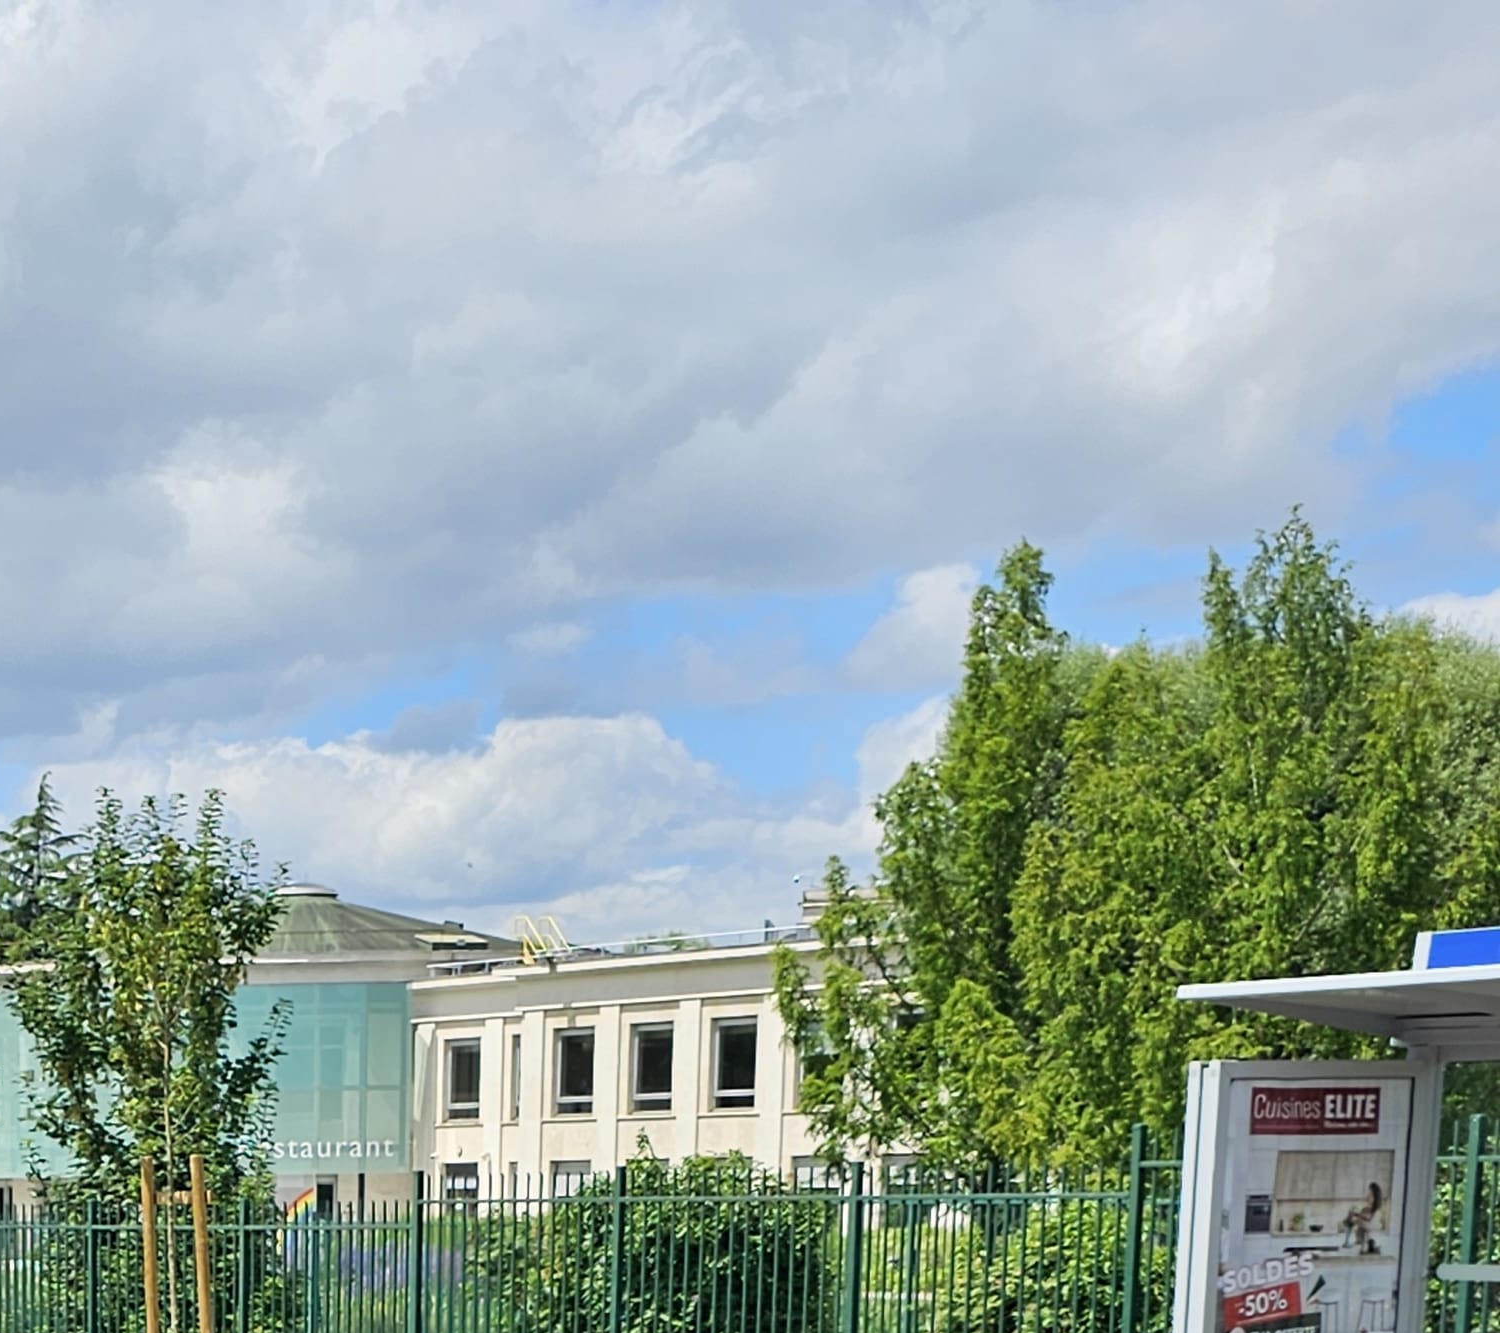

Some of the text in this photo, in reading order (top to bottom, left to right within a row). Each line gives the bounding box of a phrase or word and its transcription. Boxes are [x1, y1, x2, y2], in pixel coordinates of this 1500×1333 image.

[1253, 1094, 1377, 1119] Cuisines ELITE
[1223, 1254, 1314, 1293] SOLDES
[1238, 1289, 1288, 1316] -50%
